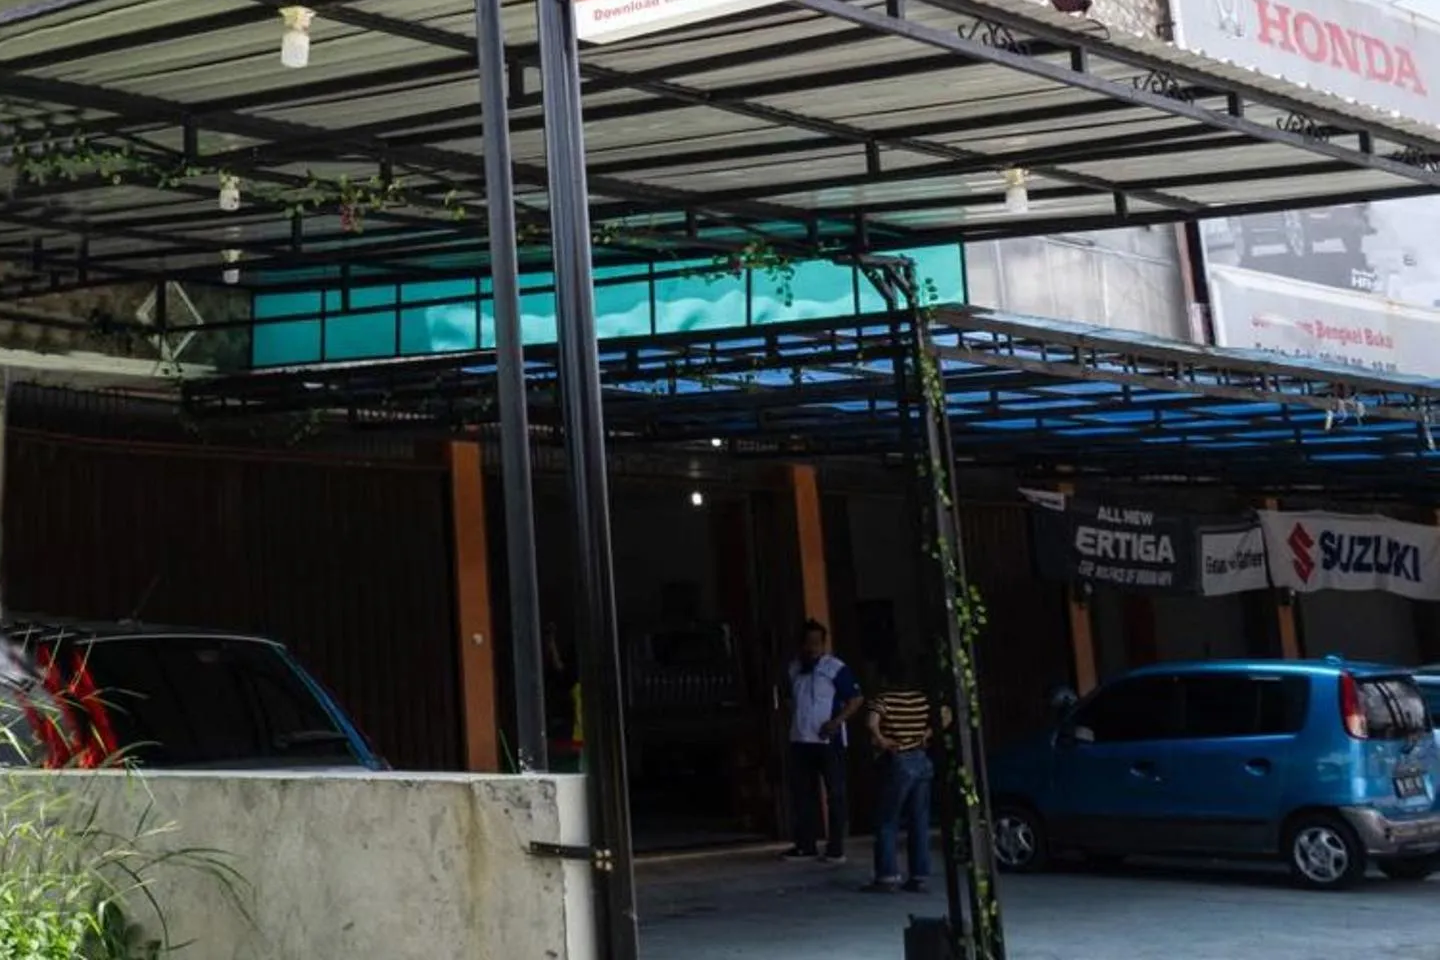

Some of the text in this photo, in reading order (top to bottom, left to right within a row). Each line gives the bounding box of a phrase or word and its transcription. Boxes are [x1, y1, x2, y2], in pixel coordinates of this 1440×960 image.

[1097, 506, 1122, 523] ALL
[1075, 526, 1176, 564] ERTIGA
[1319, 530, 1422, 585] SUZUKI
